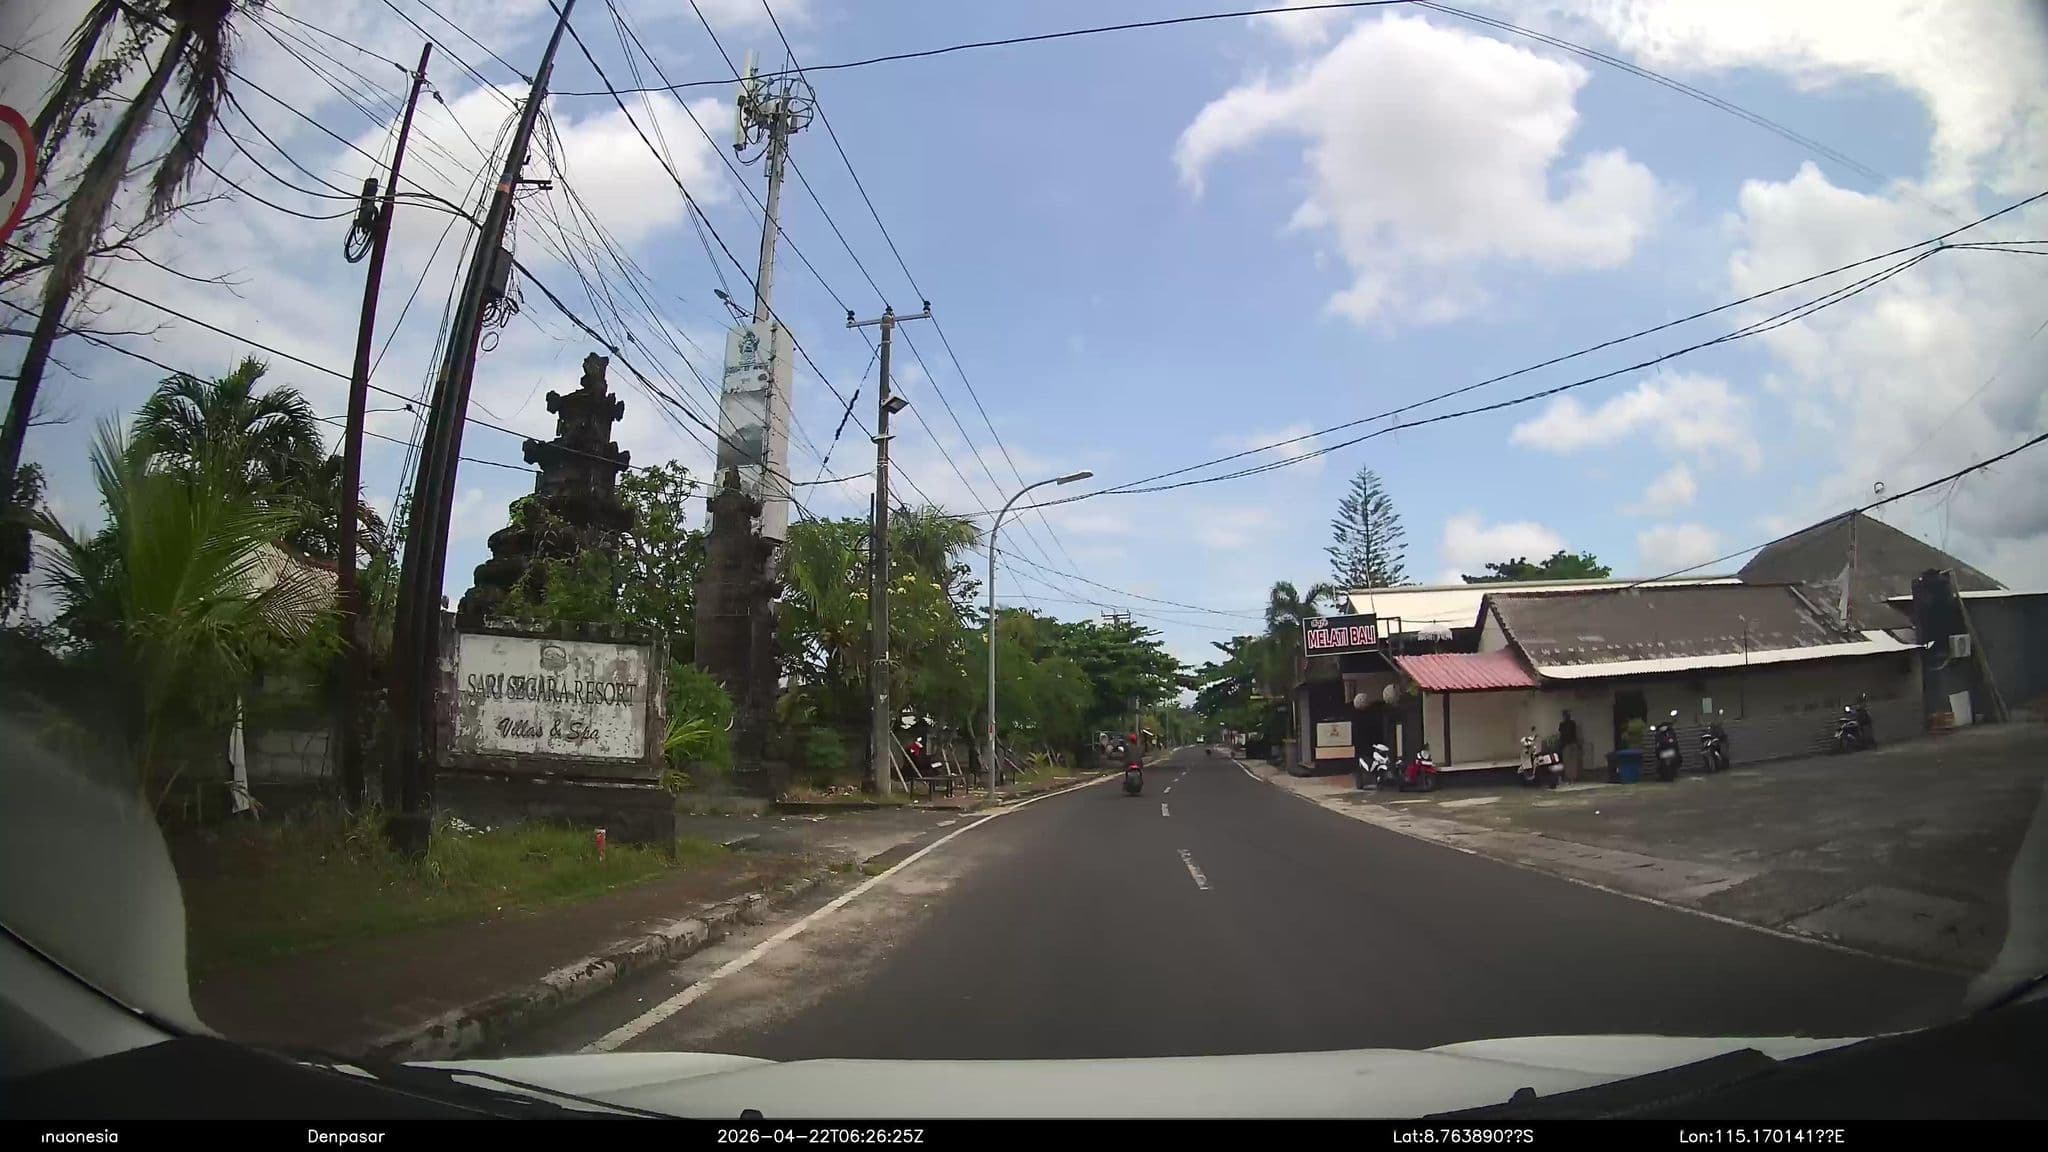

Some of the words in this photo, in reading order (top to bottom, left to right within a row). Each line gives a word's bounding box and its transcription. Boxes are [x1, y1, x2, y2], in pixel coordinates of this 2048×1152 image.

[1307, 627, 1349, 649] MELATI
[1350, 625, 1376, 646] BALI
[467, 673, 504, 700] SARI
[507, 675, 569, 704] SEGARA
[574, 680, 637, 708] RESORT
[499, 717, 544, 738] Villas
[550, 719, 563, 737] &
[566, 721, 600, 742] Spa
